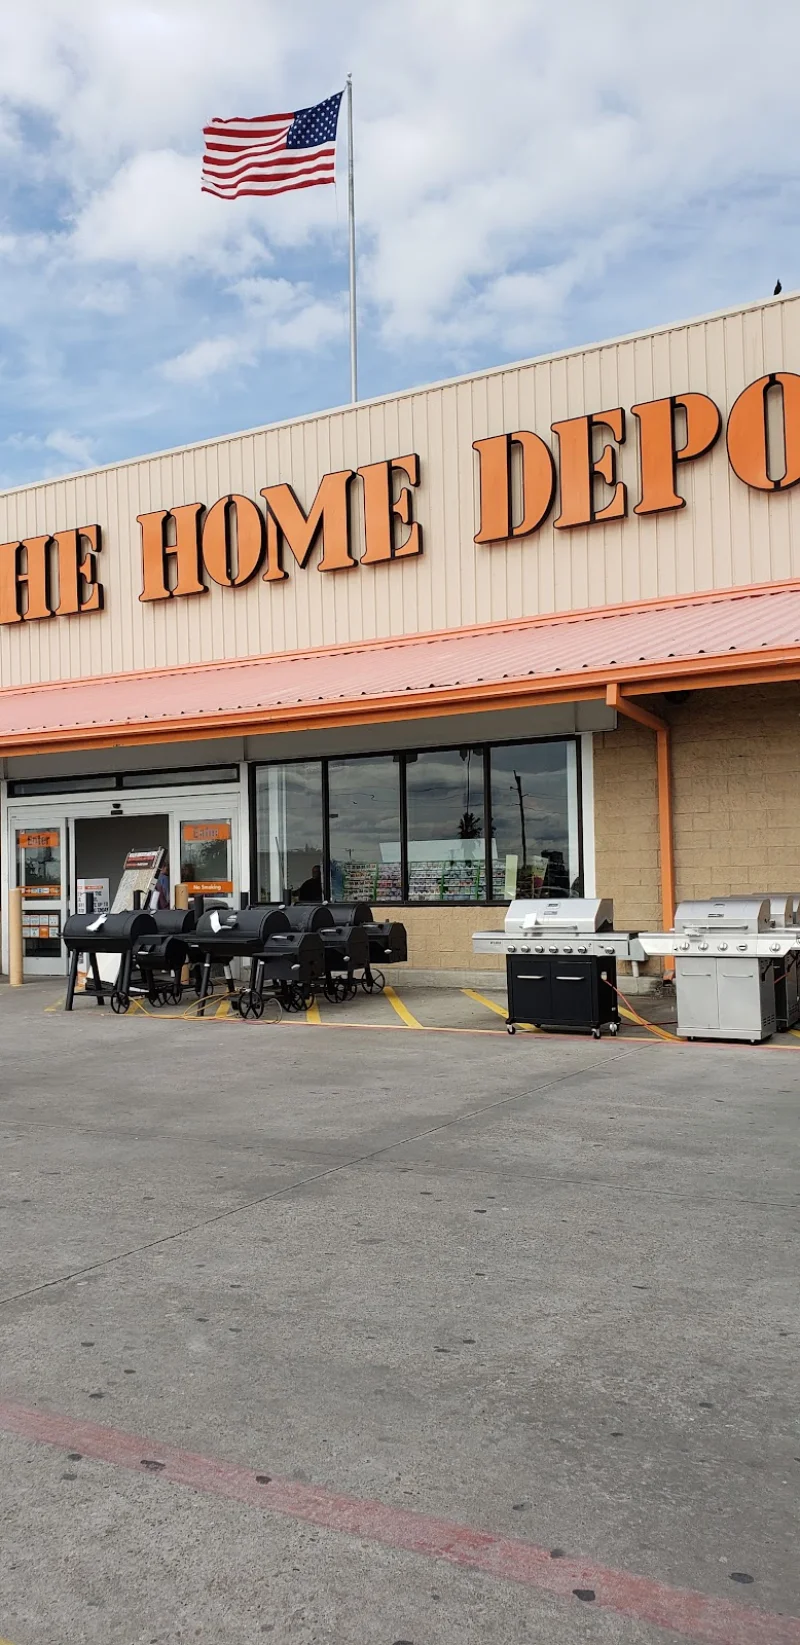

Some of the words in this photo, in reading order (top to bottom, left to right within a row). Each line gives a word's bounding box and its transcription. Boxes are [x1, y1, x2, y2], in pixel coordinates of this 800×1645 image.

[136, 453, 424, 602] HOME
[472, 371, 800, 545] DEPO
[27, 833, 50, 846] Enter
[202, 883, 222, 891] Smoking
